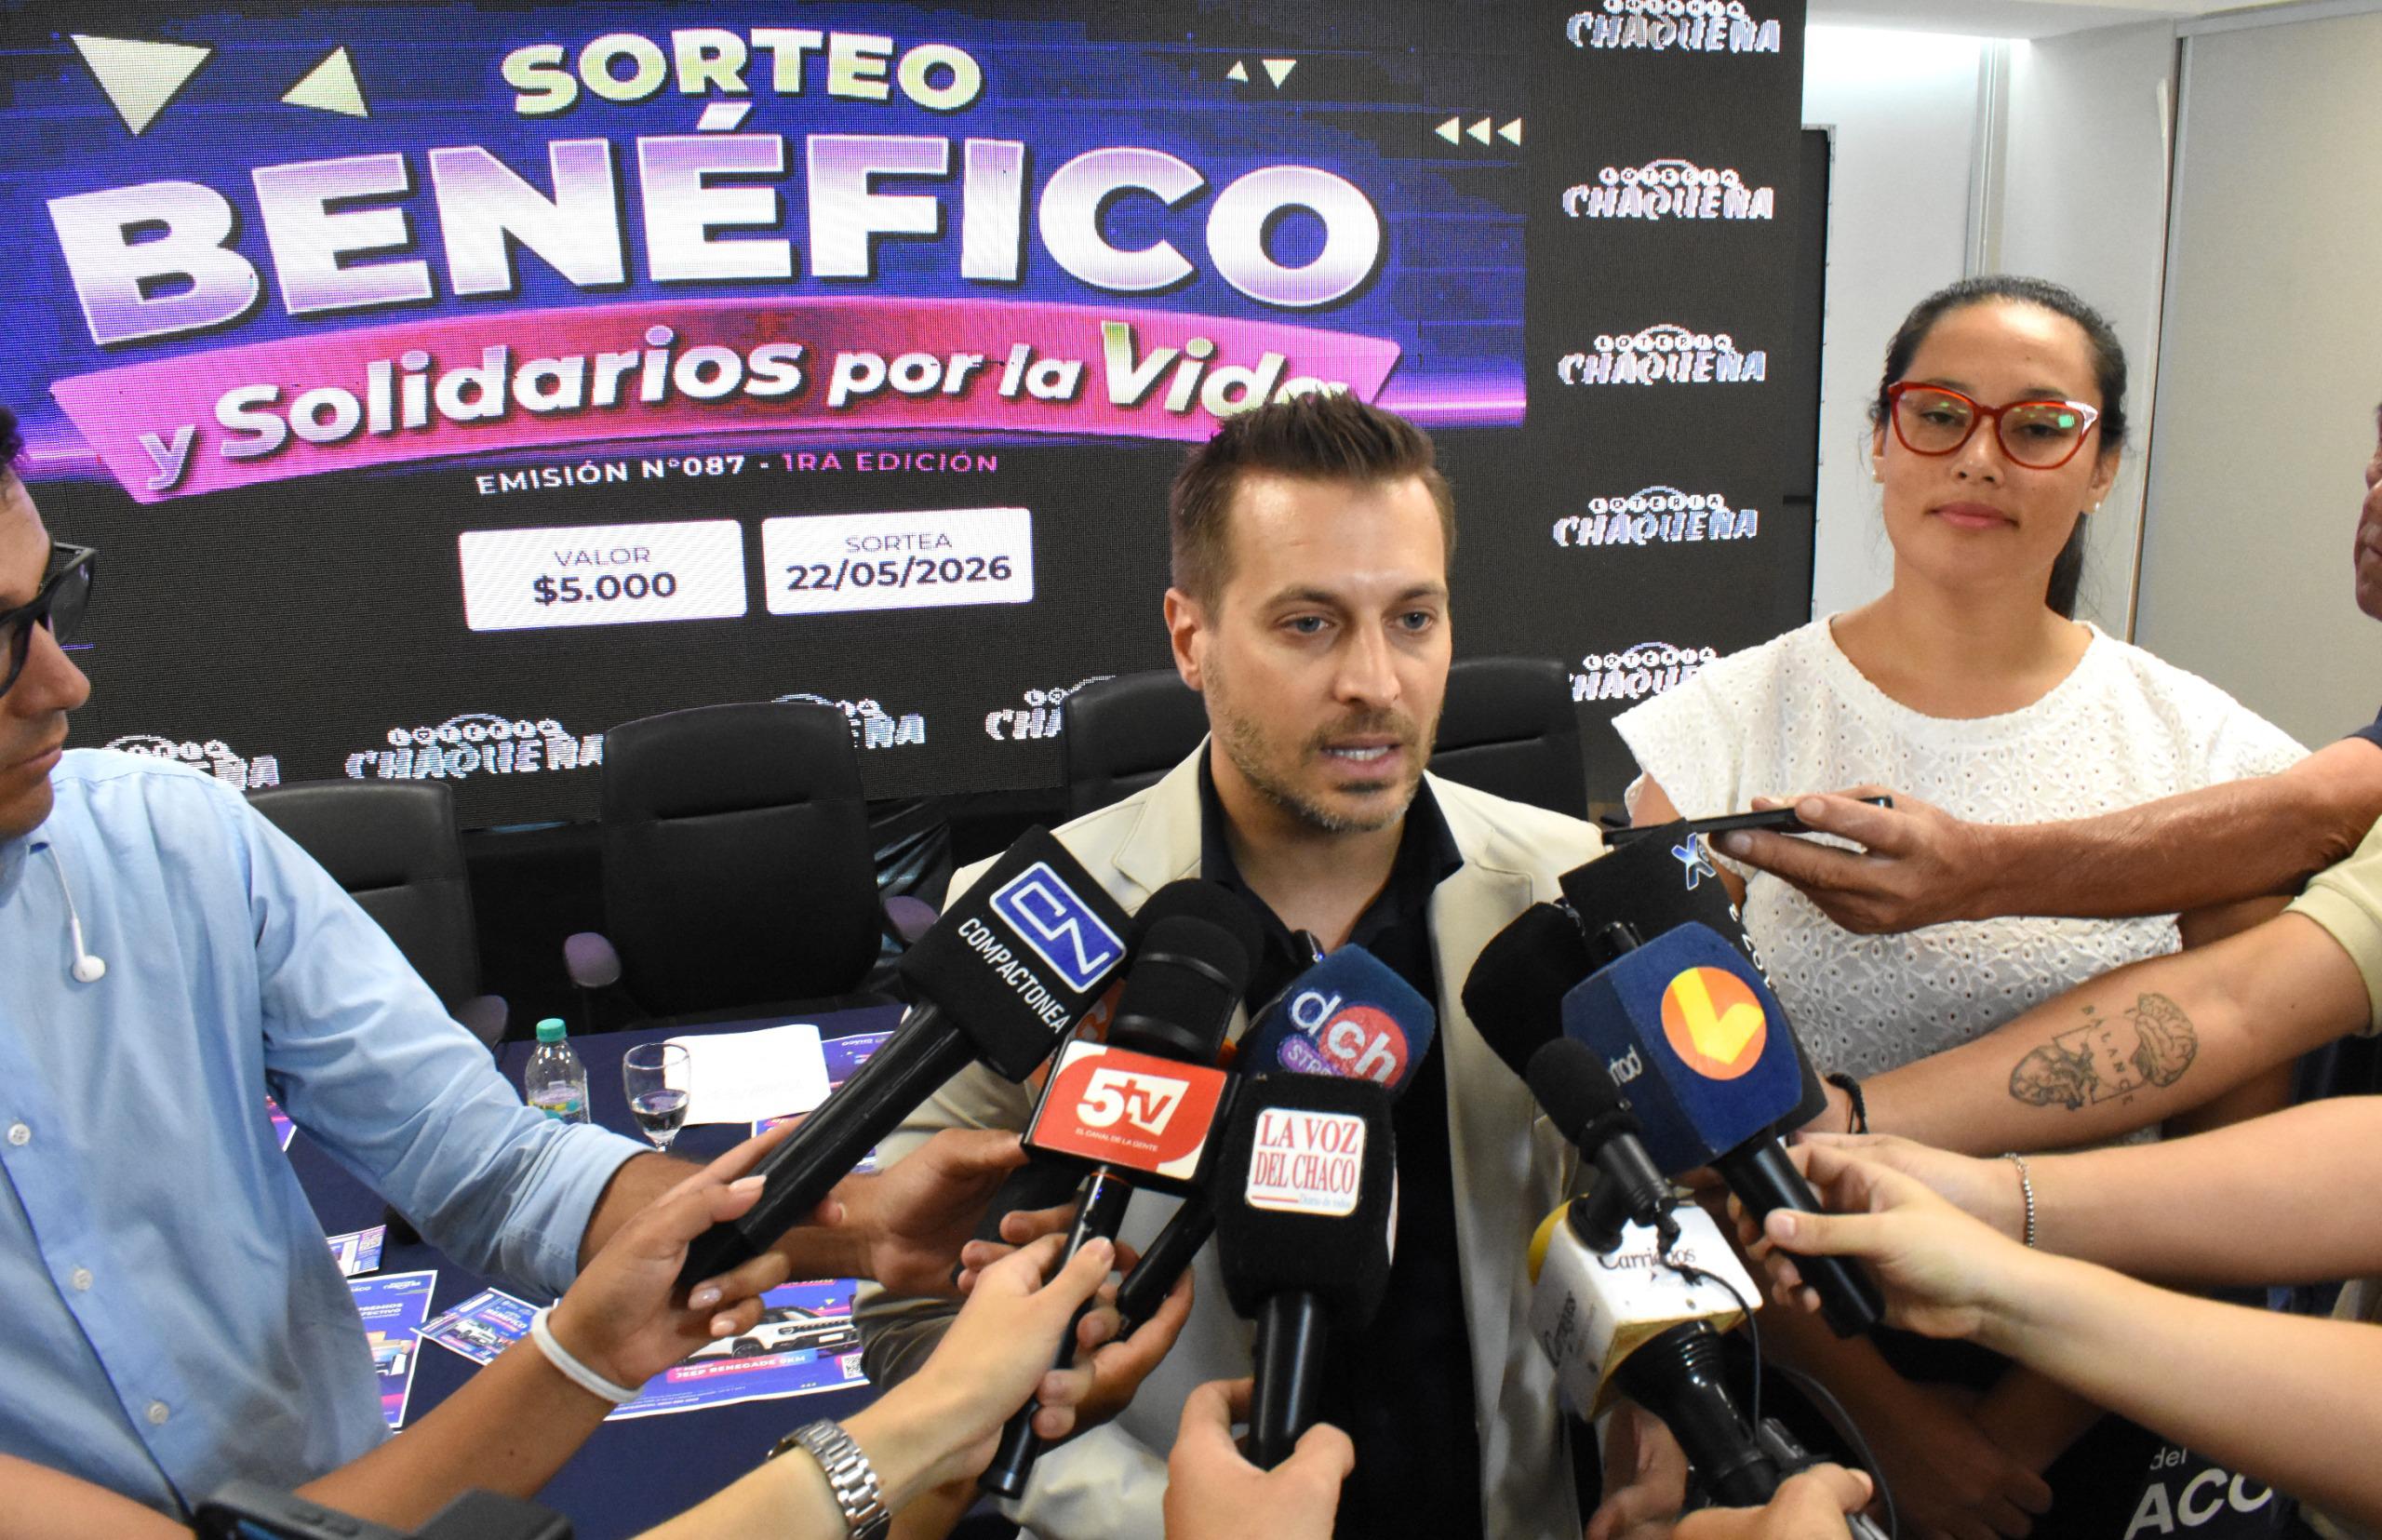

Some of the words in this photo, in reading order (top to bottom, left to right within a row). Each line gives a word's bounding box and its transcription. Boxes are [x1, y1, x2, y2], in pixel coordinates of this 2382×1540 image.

[502, 29, 983, 115] SORTEO
[47, 103, 1380, 345] BENÉFICO
[139, 423, 196, 490] y
[215, 327, 805, 457] Solidarios
[828, 353, 984, 407] por
[998, 343, 1083, 399] la
[475, 460, 628, 494] EMISIÓN
[783, 451, 842, 472] 1RA
[856, 449, 998, 473] EDICIÓN
[555, 546, 650, 567] VALOR
[845, 531, 953, 553] SORTEA
[533, 571, 677, 607] $5.000
[786, 556, 1012, 591] 22/05/2026
[957, 917, 1071, 1035] COMPACTONEA
[1260, 1115, 1295, 1148] LA
[1305, 1117, 1359, 1155] VOZ
[1253, 1151, 1288, 1188] DEL
[1291, 1154, 1356, 1195] CHACO
[676, 1369, 707, 1379] JEEP
[709, 1359, 777, 1373] RENEGADE
[2149, 1447, 2188, 1470] del
